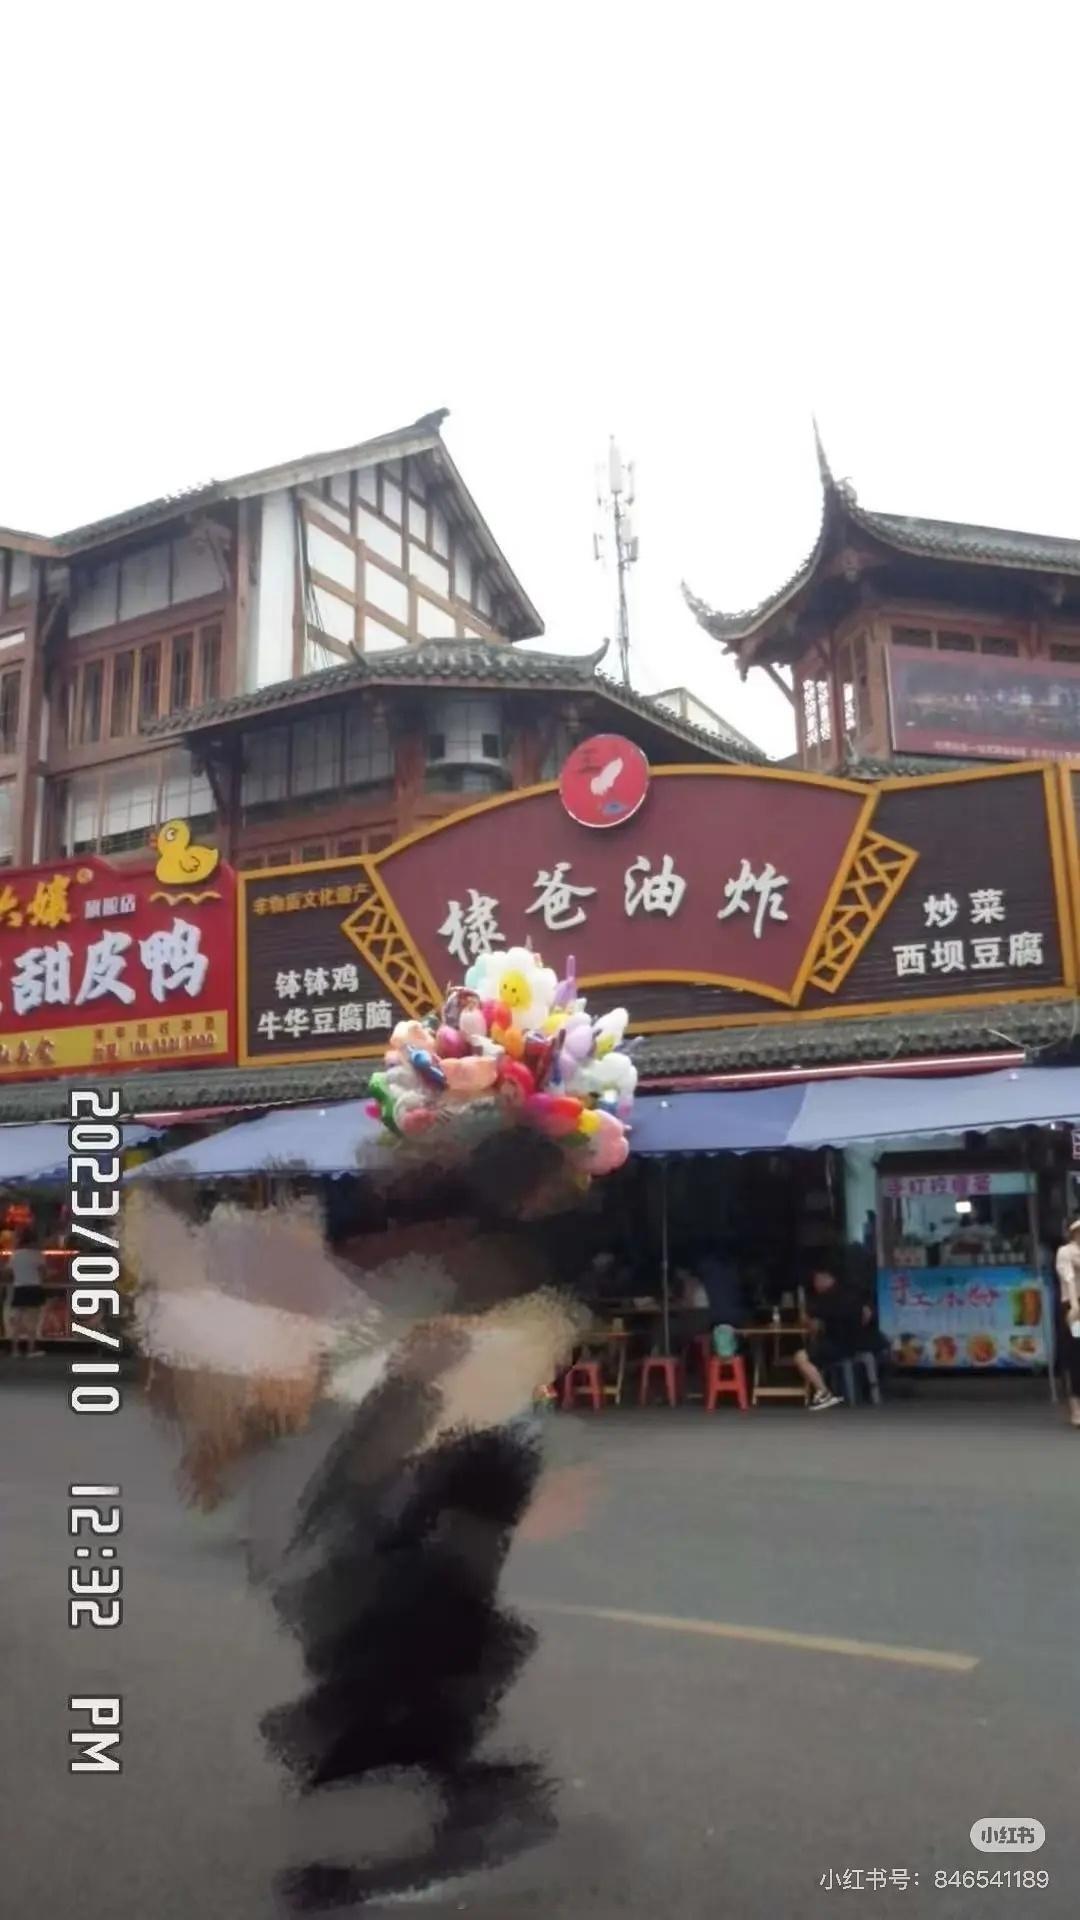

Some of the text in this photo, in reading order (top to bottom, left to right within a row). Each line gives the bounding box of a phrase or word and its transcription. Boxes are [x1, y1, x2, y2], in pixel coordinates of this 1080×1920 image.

[923, 889, 1005, 928] 炒菜
[10, 917, 210, 1016] 甜皮鸭
[892, 931, 1044, 976] 西坝豆腐
[275, 963, 359, 999] 钵钵鸡
[257, 1000, 393, 1040] 牛华豆腐脑
